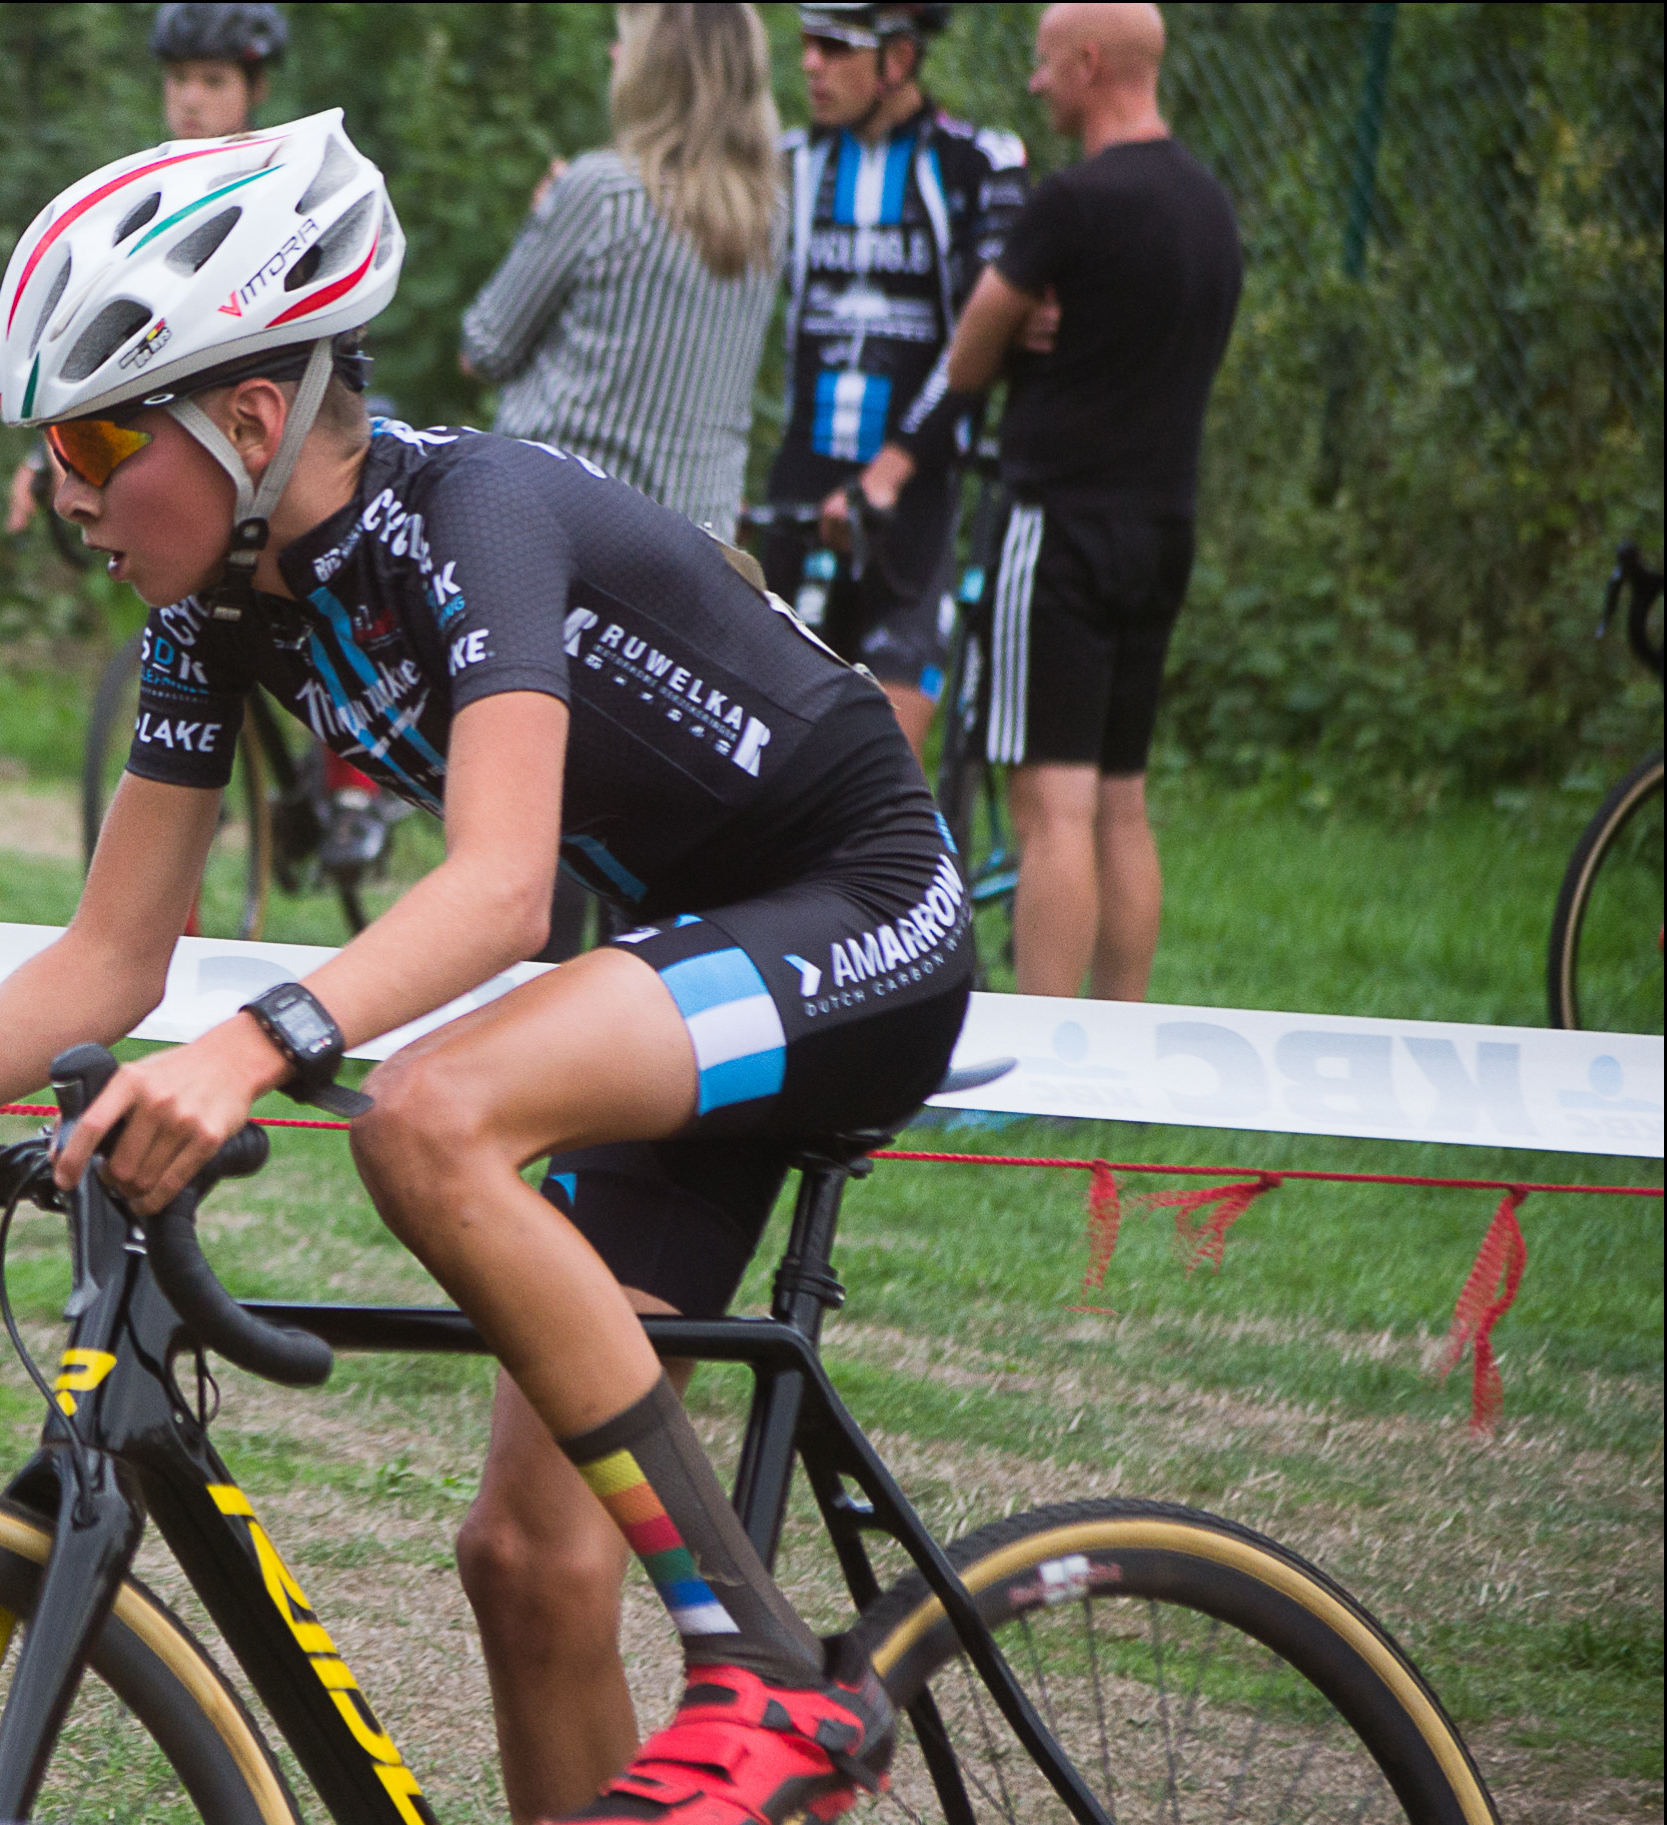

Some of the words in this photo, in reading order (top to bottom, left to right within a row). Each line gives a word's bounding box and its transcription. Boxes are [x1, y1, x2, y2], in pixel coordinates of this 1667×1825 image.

[218, 218, 320, 318] VITTORIA
[449, 628, 490, 677] KE
[599, 623, 744, 731] RUWELKA
[139, 712, 223, 752] LAKE
